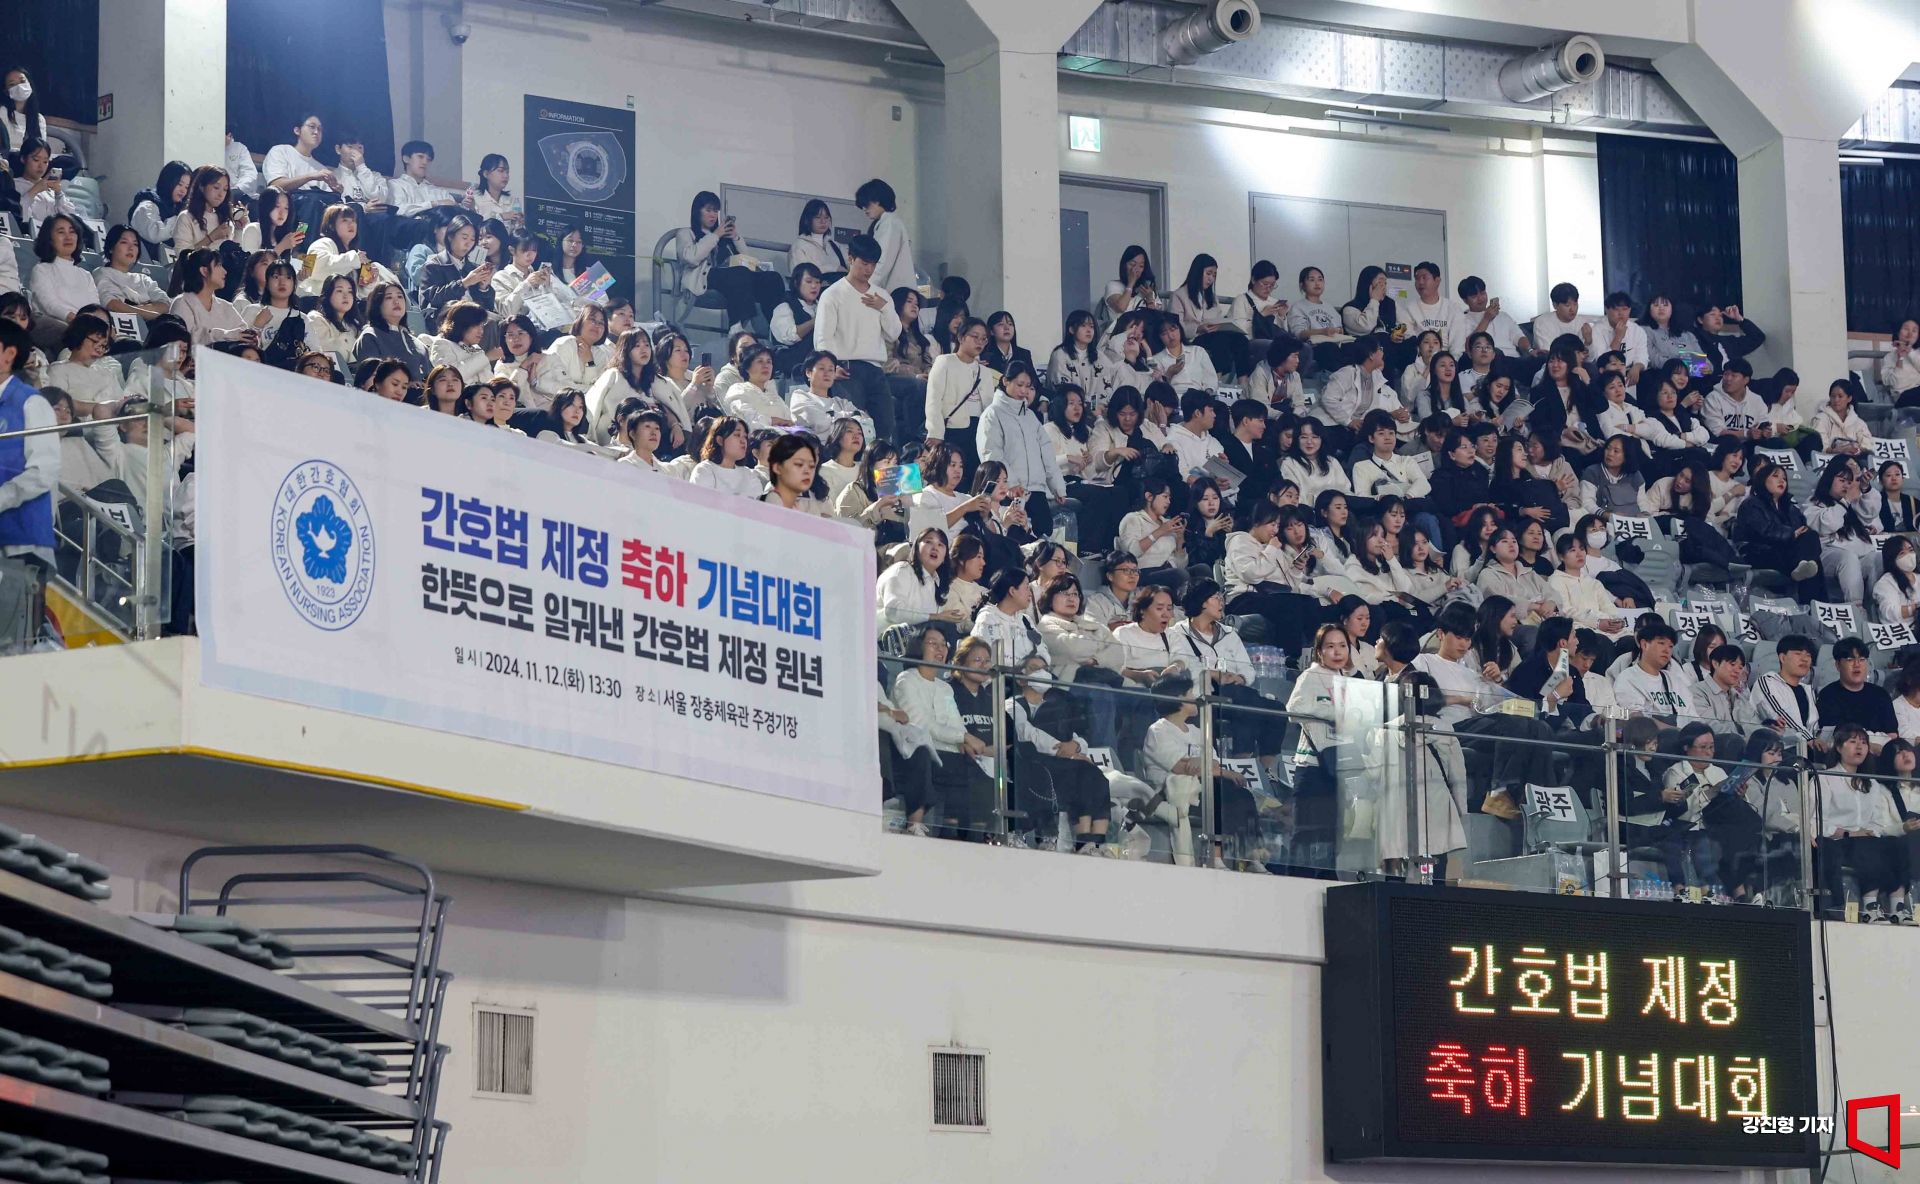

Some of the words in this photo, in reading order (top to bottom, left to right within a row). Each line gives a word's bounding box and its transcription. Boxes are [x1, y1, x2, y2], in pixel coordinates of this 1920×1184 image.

[548, 112, 585, 123] INFORMATION
[584, 225, 593, 233] B2
[284, 465, 362, 515] 대한간호협회
[276, 506, 294, 581] KOREAN
[290, 581, 337, 623] NURSING
[338, 525, 372, 622] ASSOCIATION
[316, 585, 335, 597] 1923
[421, 486, 528, 570] 간호법
[541, 518, 609, 588] 제정
[621, 538, 688, 607] 축하
[698, 558, 822, 640] 기념대회
[421, 562, 535, 632] 한뜻으로
[544, 592, 624, 653] 일궈낸
[633, 612, 710, 673] 간호법
[718, 634, 767, 685] 제정
[775, 647, 824, 698] 원년
[1872, 623, 1911, 647] 경북
[589, 674, 622, 699] 13:30
[663, 689, 687, 716] 서울
[690, 694, 750, 728] 장충체육관
[752, 708, 798, 739] 주경기장
[1534, 790, 1572, 818] 광주
[1449, 944, 1610, 1020] 간호법
[1642, 955, 1738, 1026] 제정
[1425, 1043, 1533, 1116] 축하
[1561, 1050, 1770, 1122] 기념대회
